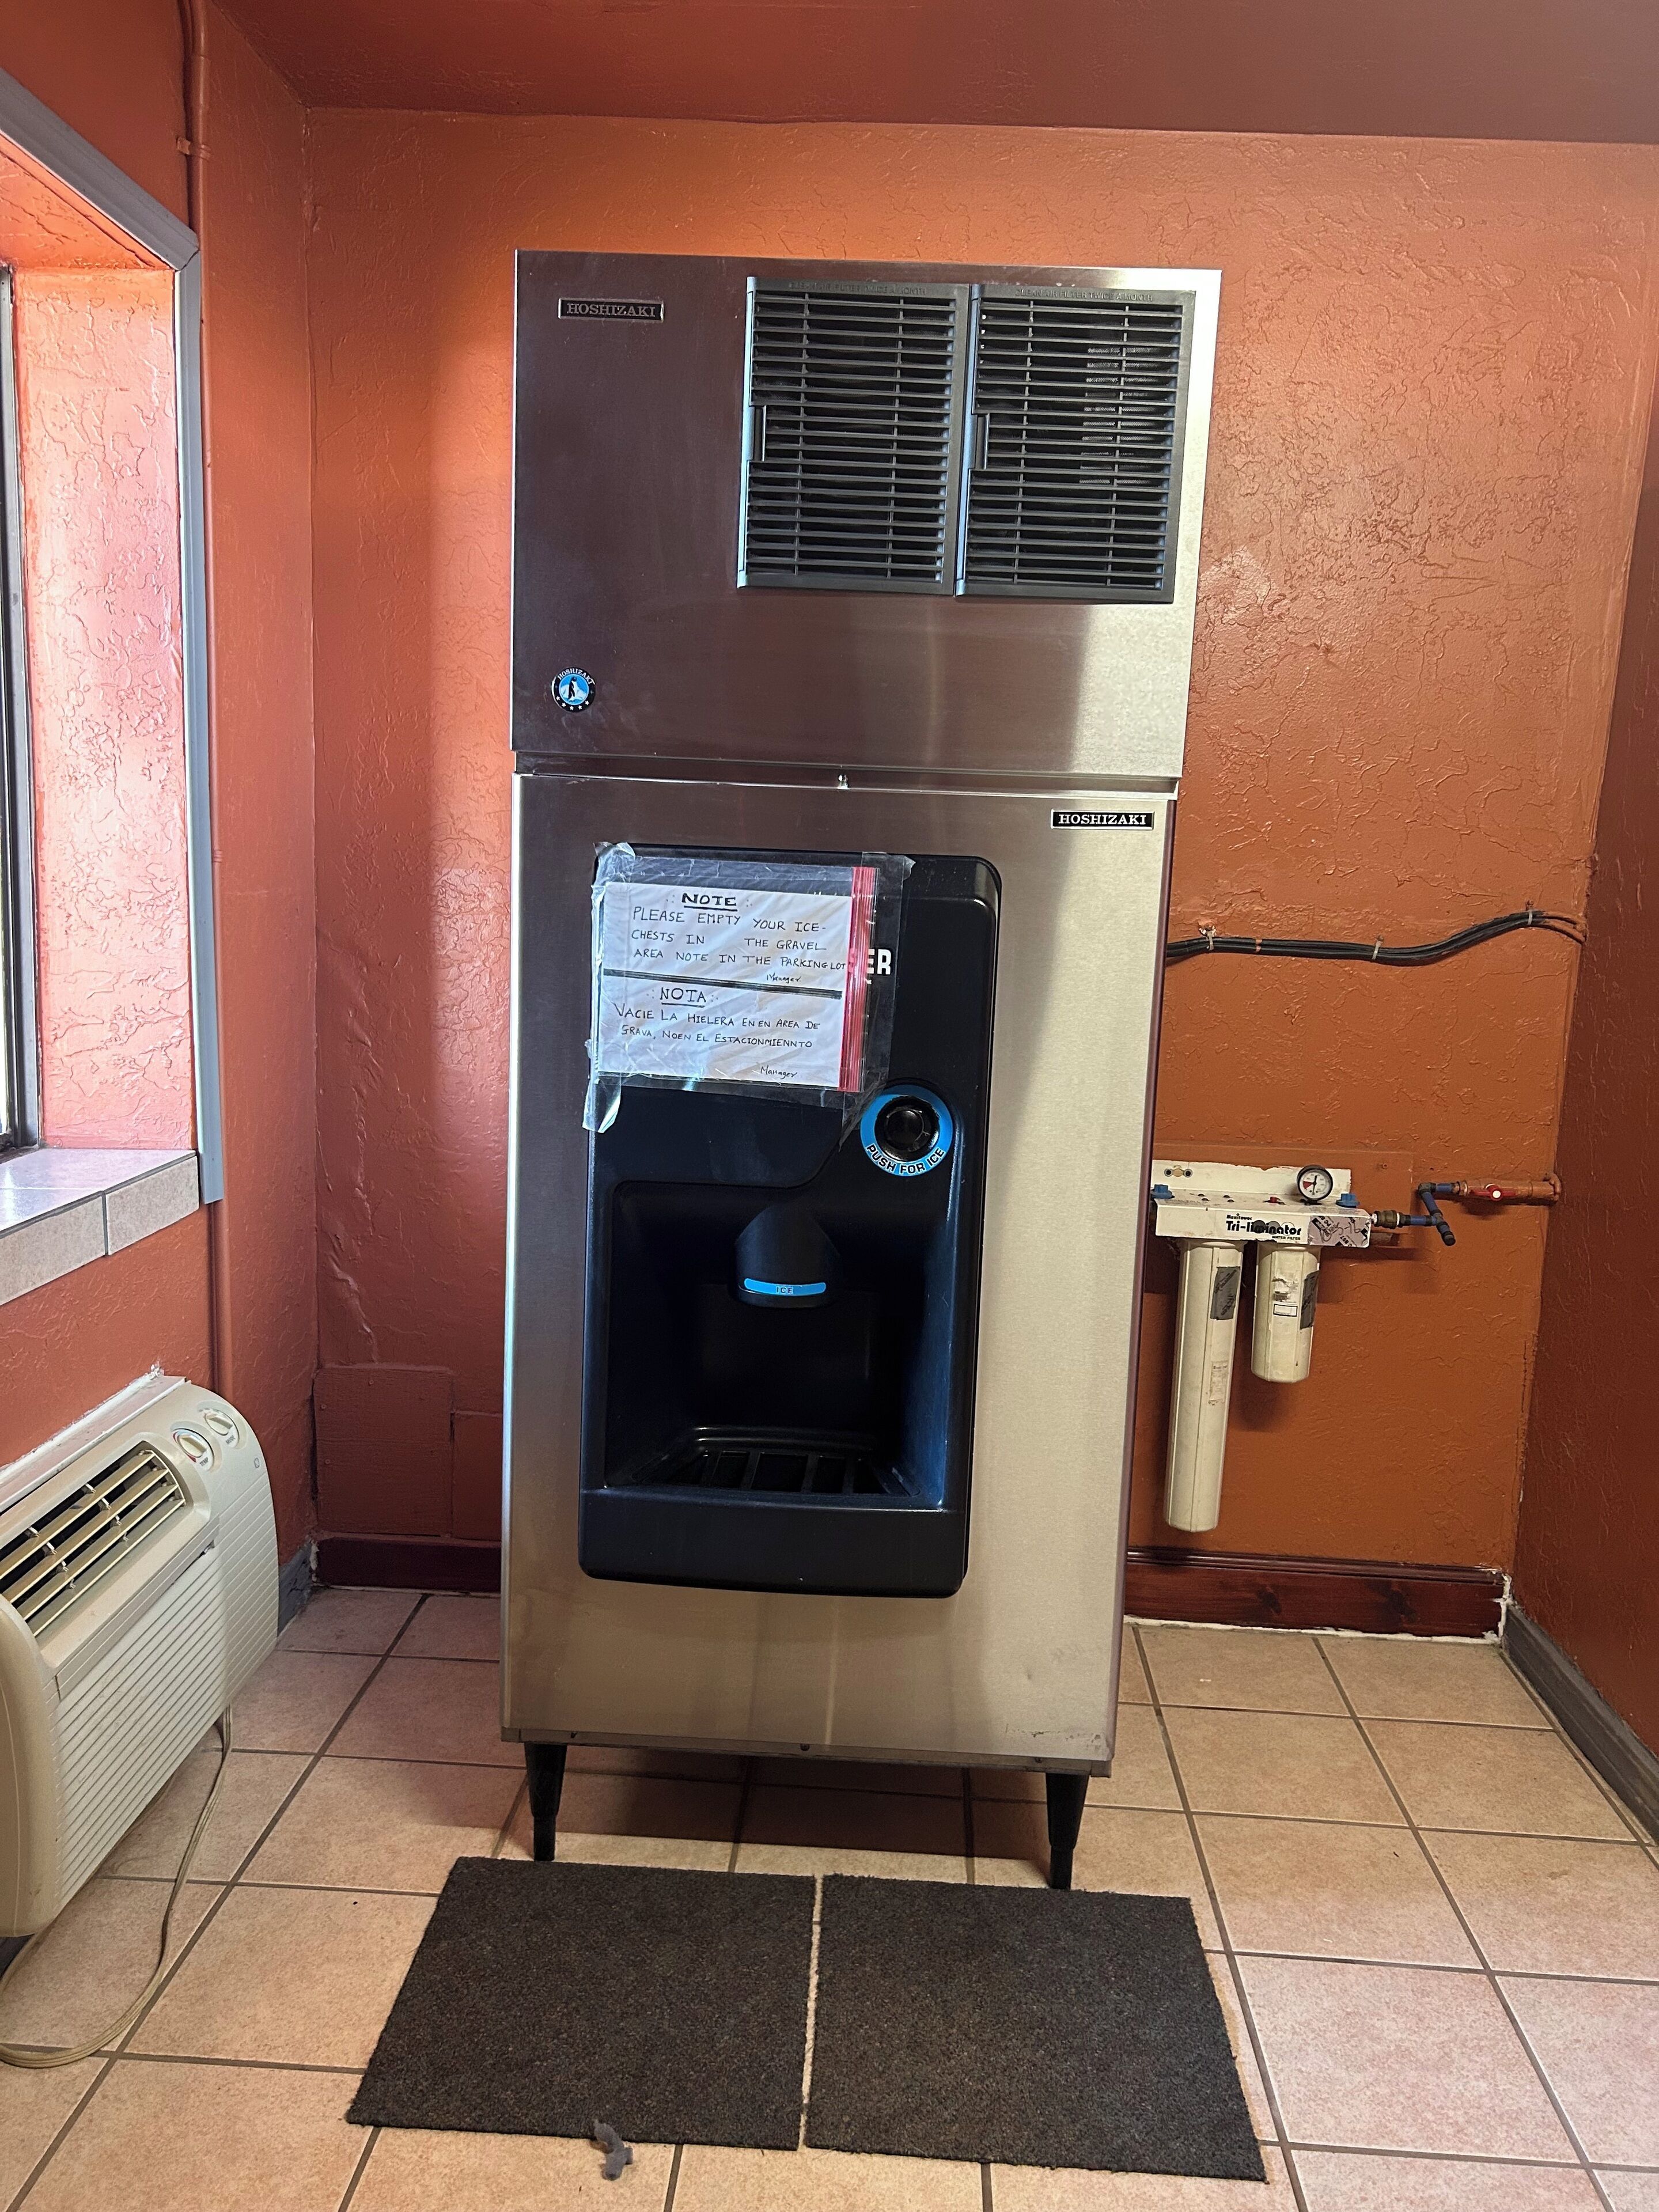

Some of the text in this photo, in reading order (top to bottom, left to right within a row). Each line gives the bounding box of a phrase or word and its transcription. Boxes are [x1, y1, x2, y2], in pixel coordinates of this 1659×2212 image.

[566, 303, 656, 317] HOSHIZAKI
[557, 668, 596, 685] HOSHIZAKI
[1058, 813, 1147, 825] HOSHIZAKI
[681, 892, 737, 907] NOTE
[632, 906, 685, 923] PLEASE
[697, 912, 741, 926] EMPTY
[752, 918, 786, 931] YOUR
[631, 929, 827, 950] CHESTS IN THE GRAVEL
[633, 948, 664, 959] AREA
[676, 951, 709, 962] NOTE
[719, 954, 736, 963] IN
[742, 955, 771, 965] THE
[659, 986, 707, 1003] NOTA
[613, 1002, 655, 1020] VACIE
[660, 1009, 678, 1021] LA
[687, 1013, 735, 1027] HIELERA
[775, 1018, 800, 1029] AREA
[804, 1020, 821, 1030] DE
[696, 1033, 710, 1043] EL
[760, 1065, 798, 1080] Manager
[866, 1143, 945, 1174] PUSH FOR ICE
[1225, 1220, 1302, 1236] Tri-liminator
[776, 1286, 793, 1294] ICE
